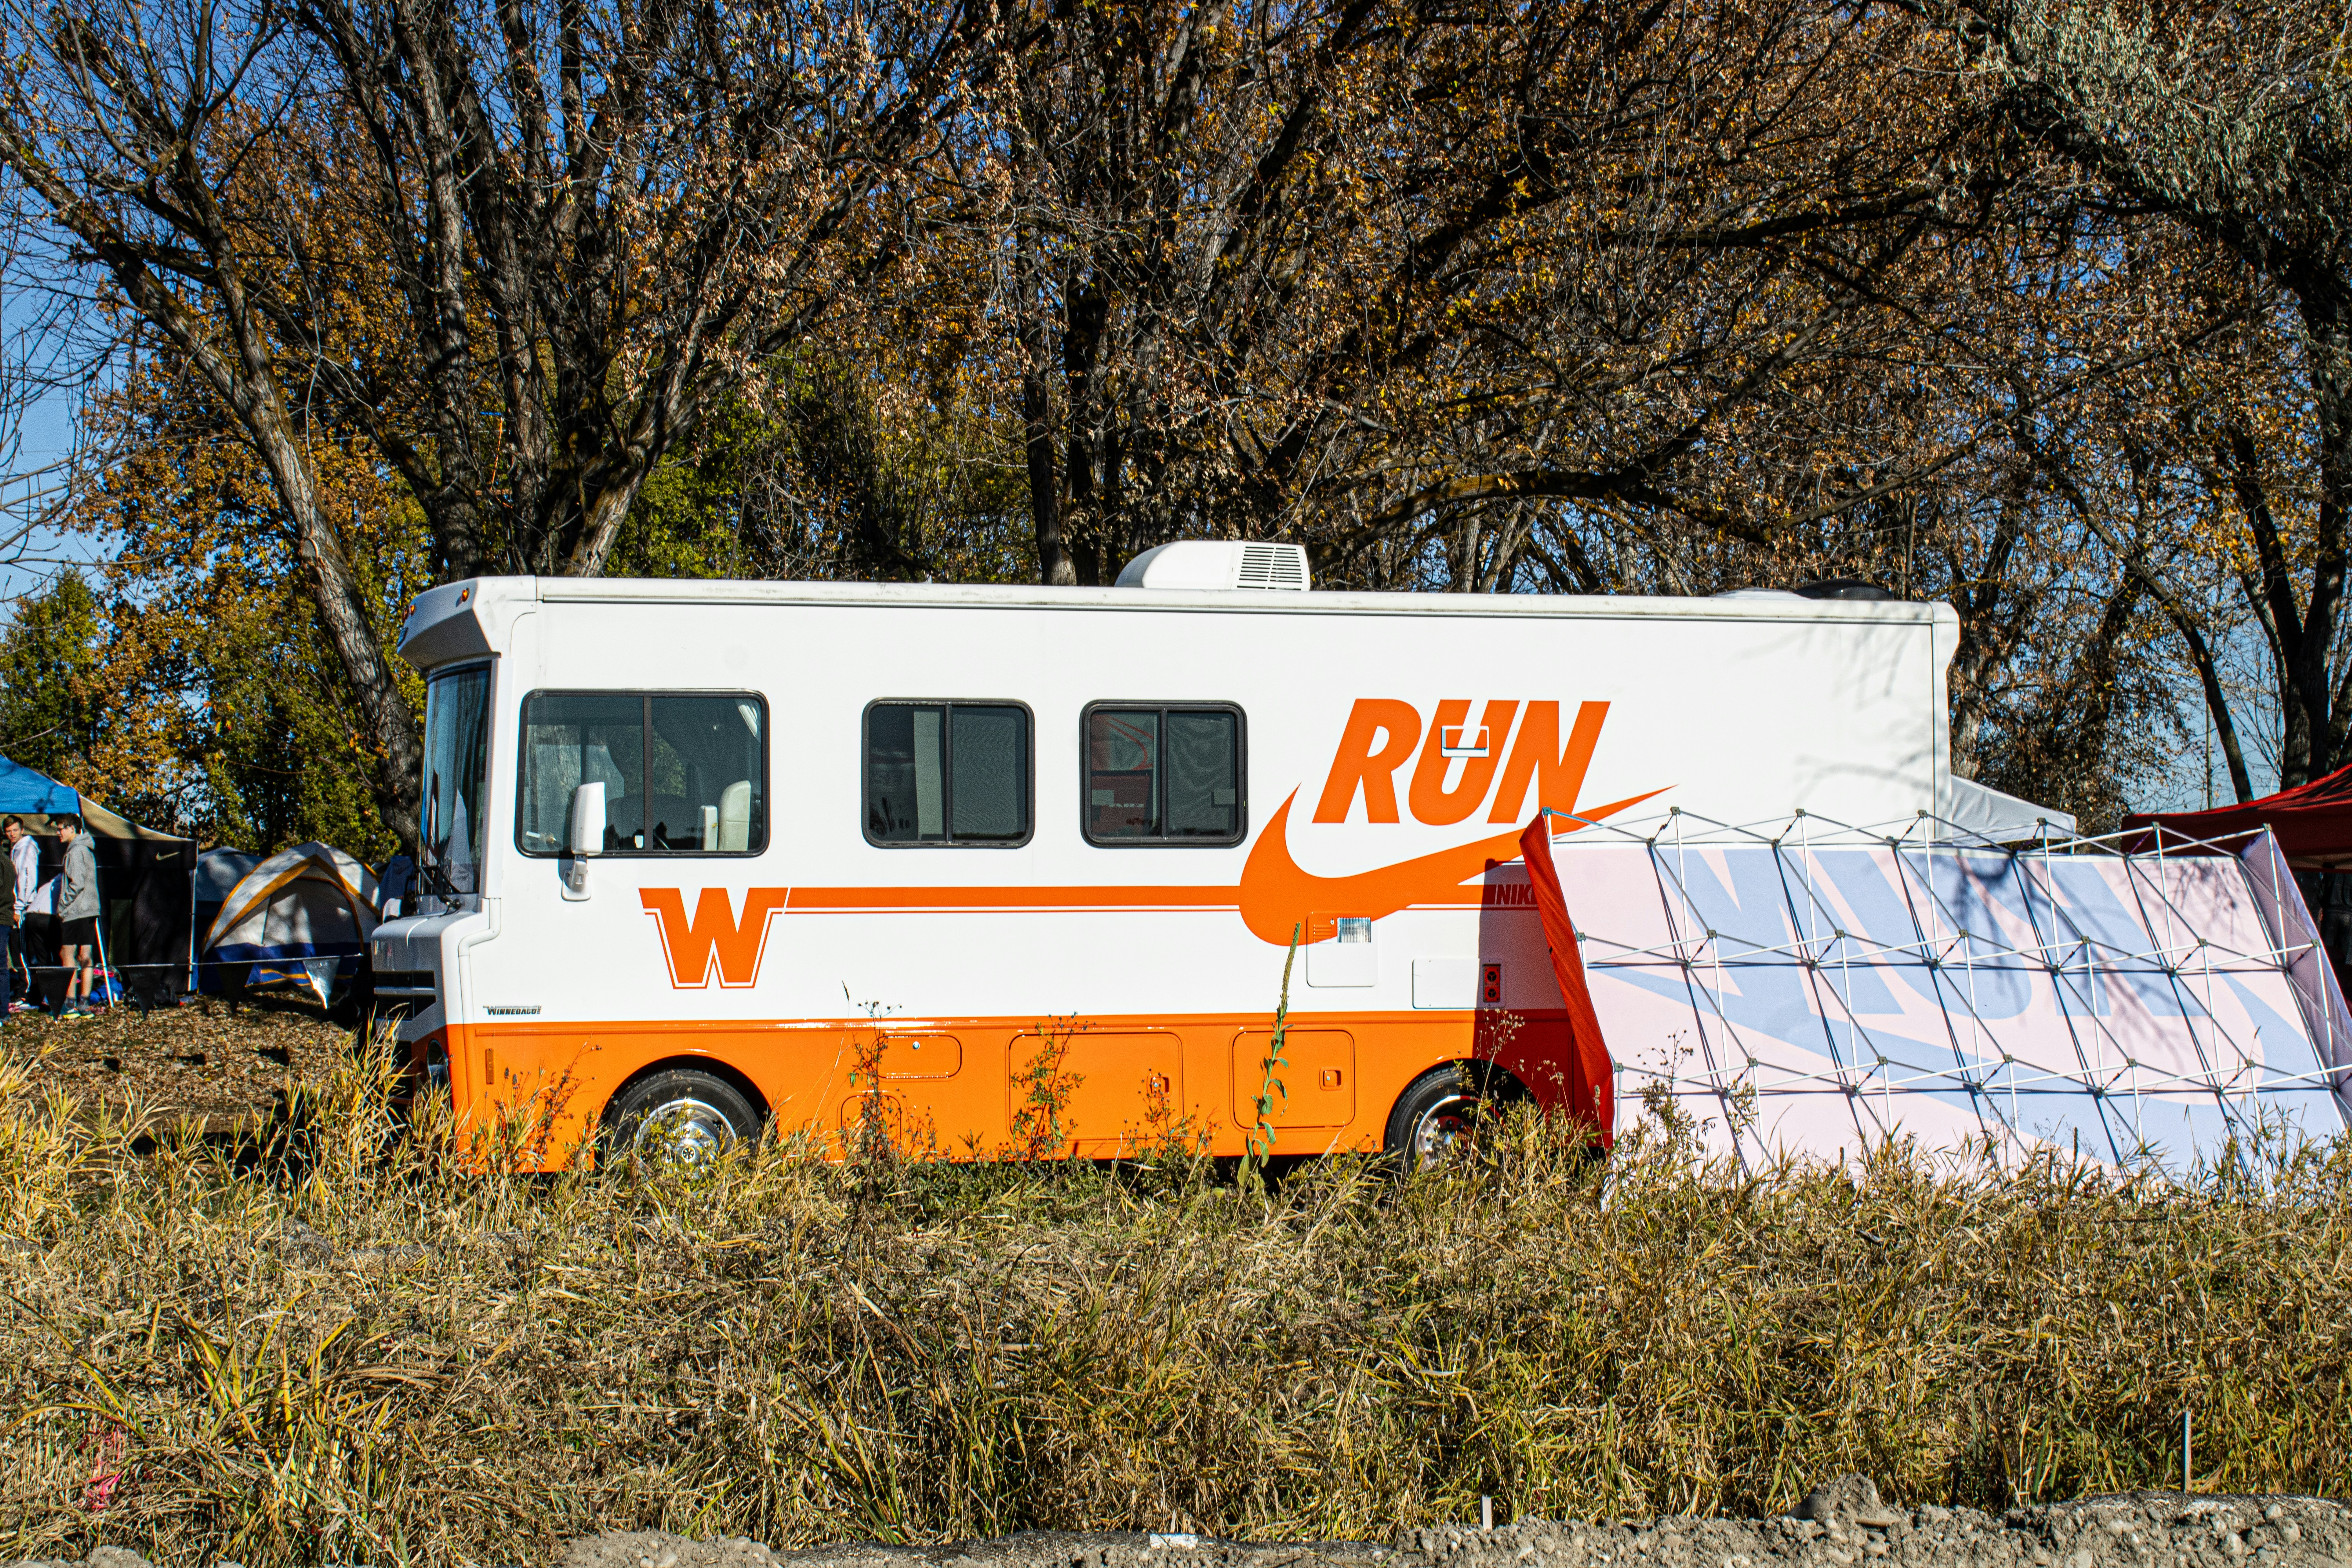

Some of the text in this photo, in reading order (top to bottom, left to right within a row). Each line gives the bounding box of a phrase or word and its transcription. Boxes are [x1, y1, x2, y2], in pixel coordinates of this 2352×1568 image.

[1312, 698, 1612, 826] RUN
[1496, 884, 1537, 905] NIK
[638, 887, 789, 989] W
[483, 1005, 537, 1015] WINNEBAGO
